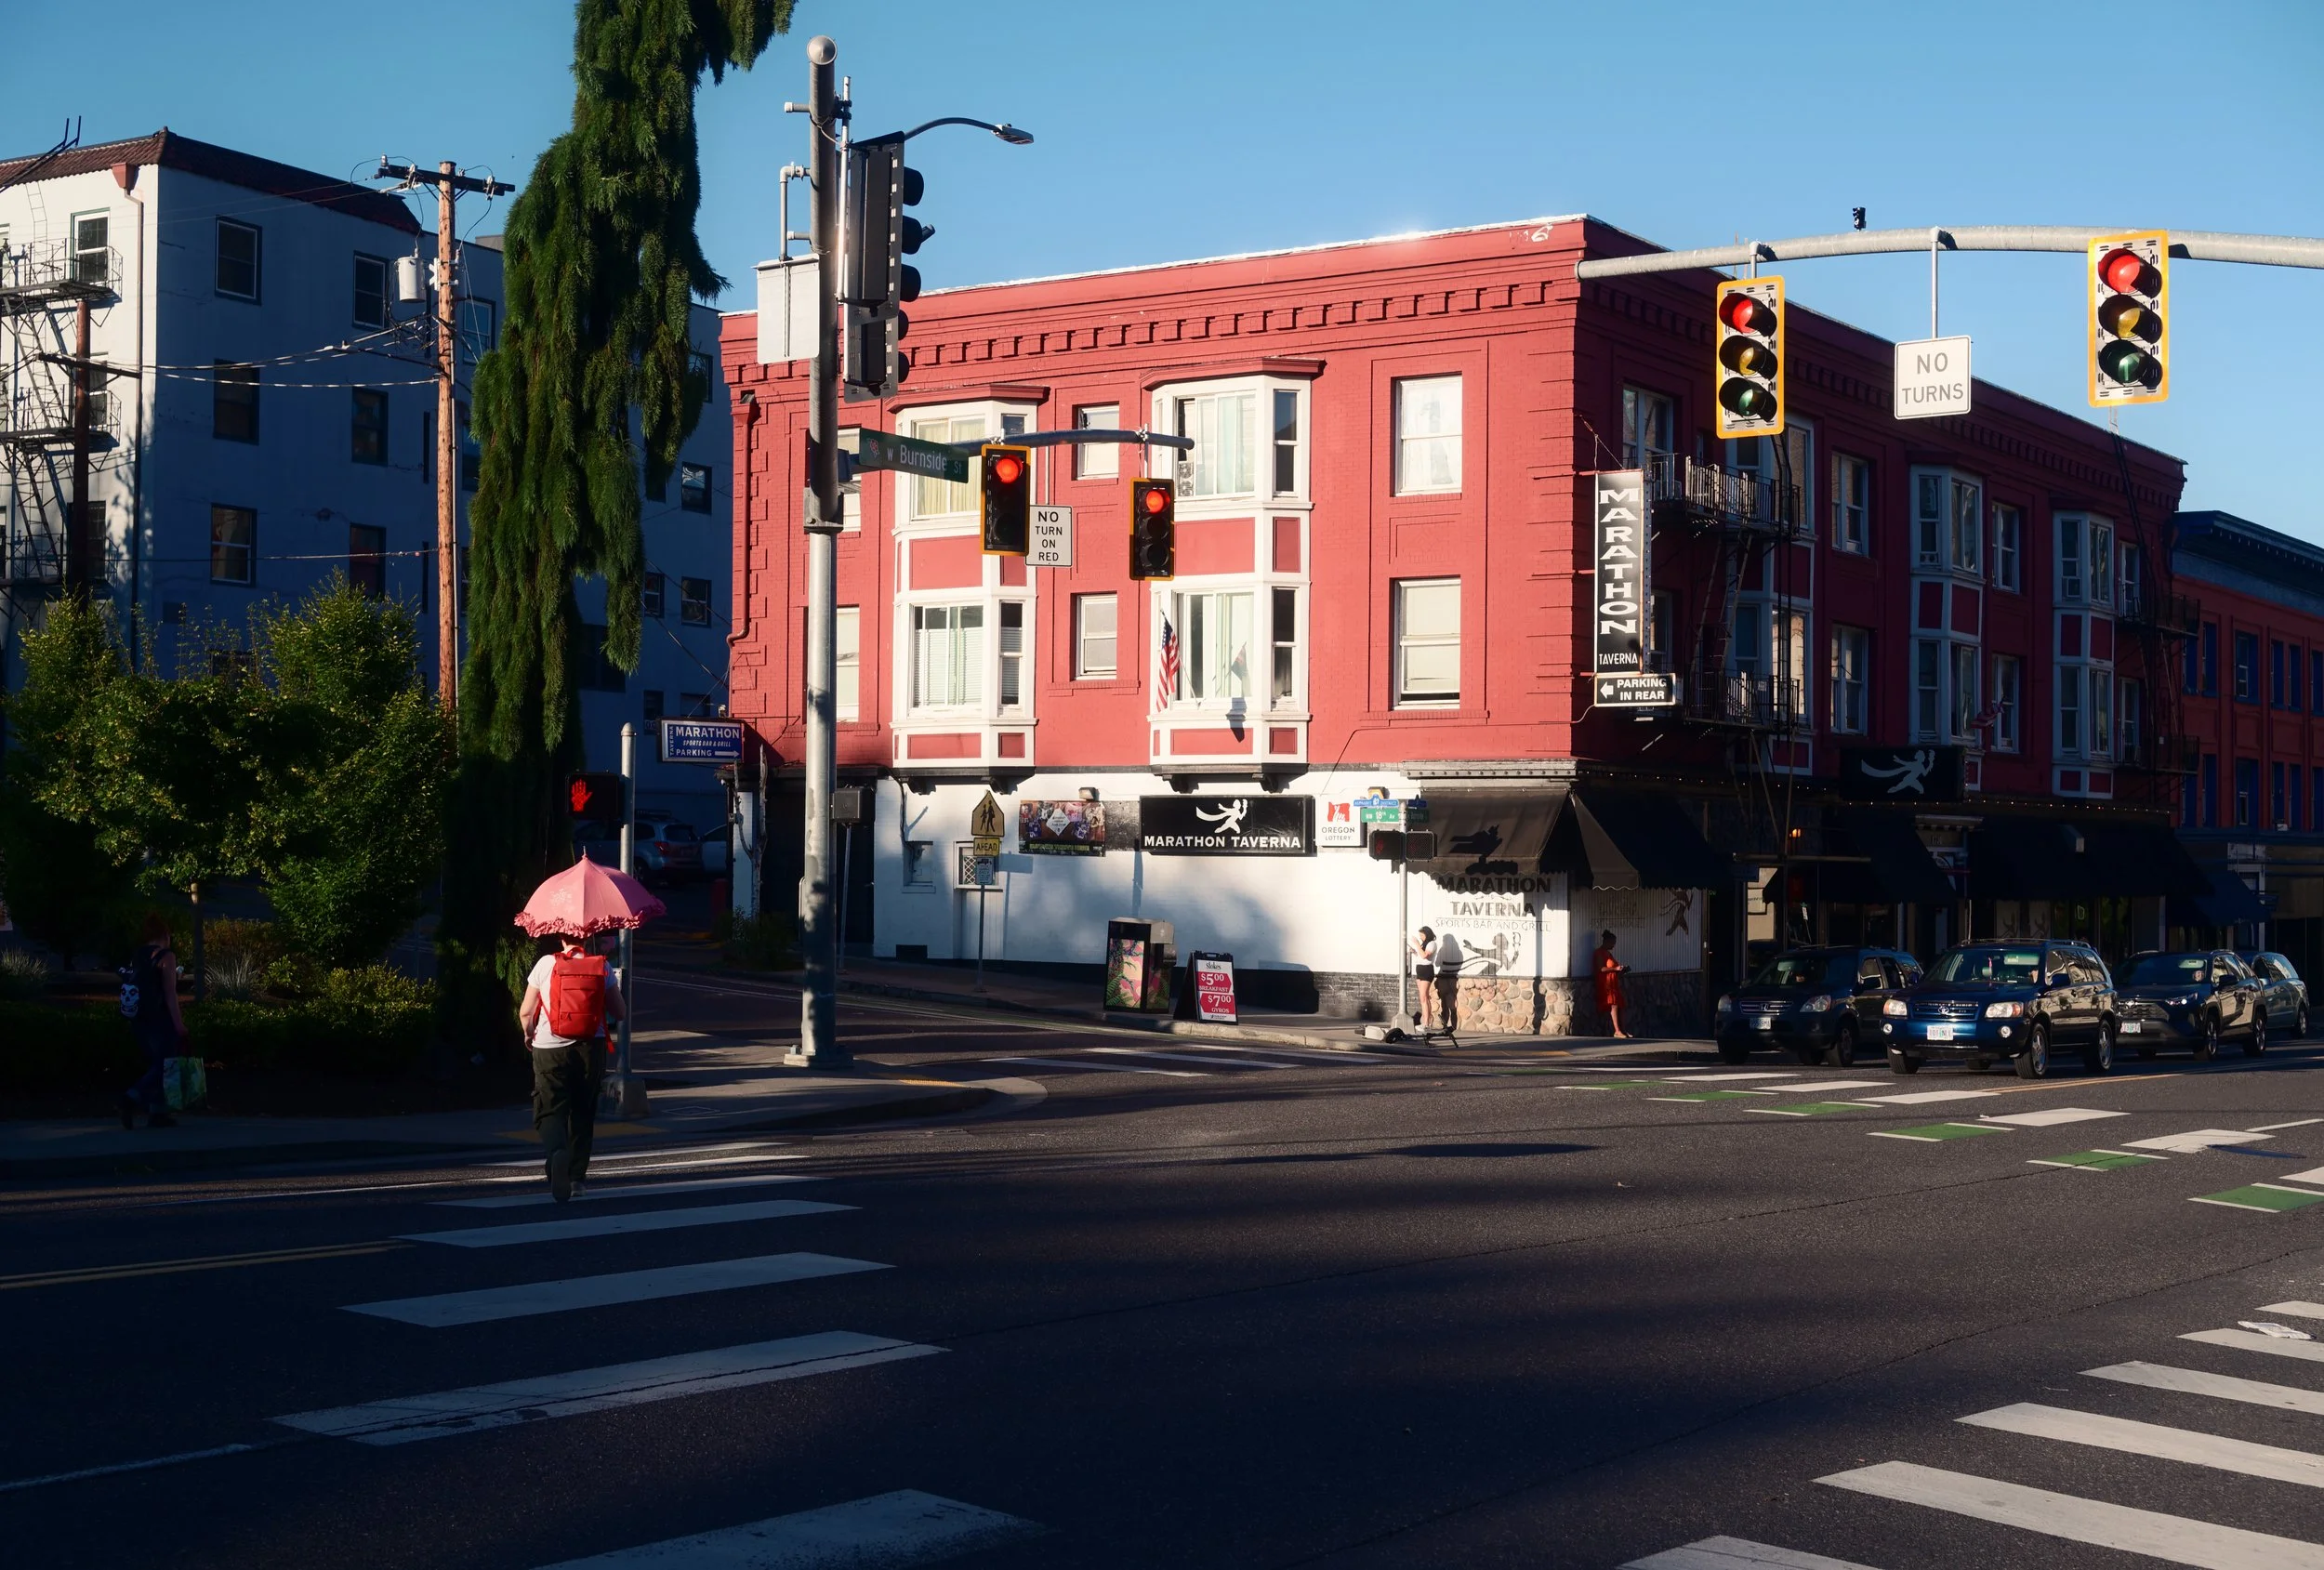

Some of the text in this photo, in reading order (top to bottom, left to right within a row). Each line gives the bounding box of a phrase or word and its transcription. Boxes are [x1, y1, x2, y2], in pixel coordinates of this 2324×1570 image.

[1917, 352, 1948, 375] NO
[1901, 382, 1964, 405] TURNS
[887, 444, 963, 474] W Burnside St
[1038, 510, 1059, 522] NO
[1035, 526, 1063, 535] TURN
[1042, 539, 1056, 548] ON
[1038, 552, 1059, 561] RED
[1599, 488, 1640, 635] MARATHON
[1599, 653, 1638, 665] TAVERNA
[1617, 678, 1667, 688] PARKING
[1619, 690, 1665, 701] IN REAR
[676, 726, 740, 740] MARATHON
[676, 748, 712, 758] PARKING
[1321, 826, 1355, 835] OREGON
[976, 842, 997, 851] AHEAD
[1144, 836, 1301, 848] MARATHON TAVERNA
[1437, 877, 1552, 893] MARATHON
[1450, 902, 1536, 917] TAVERNA
[1435, 919, 1552, 932] SPORTS BAR AND GRILL
